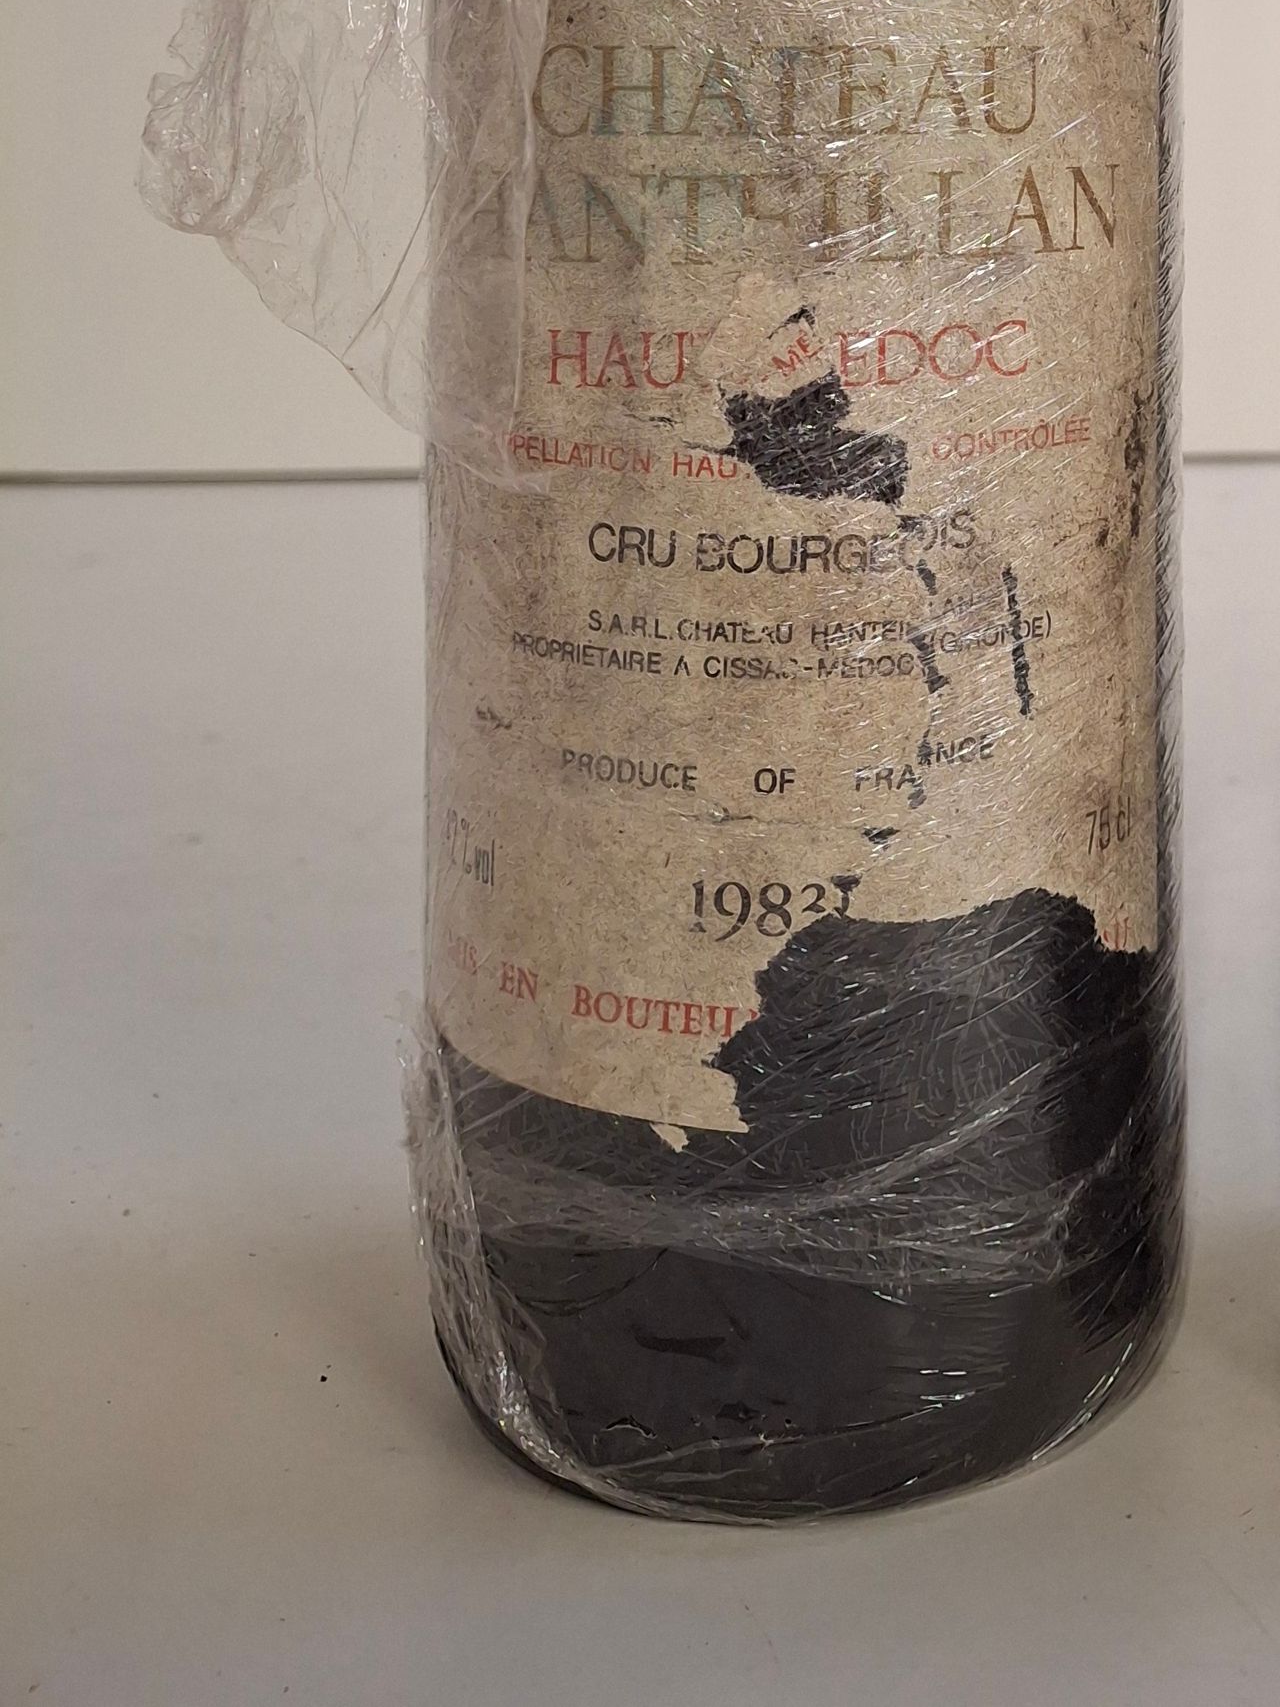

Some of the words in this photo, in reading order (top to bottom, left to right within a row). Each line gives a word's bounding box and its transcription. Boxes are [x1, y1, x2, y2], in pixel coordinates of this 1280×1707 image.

[532, 43, 1038, 137] CHATEAU
[672, 451, 750, 480] HAU
[588, 522, 677, 568] CRU
[562, 748, 698, 792] PRODUCE
[753, 767, 797, 794] OF
[499, 961, 540, 1003] EN
